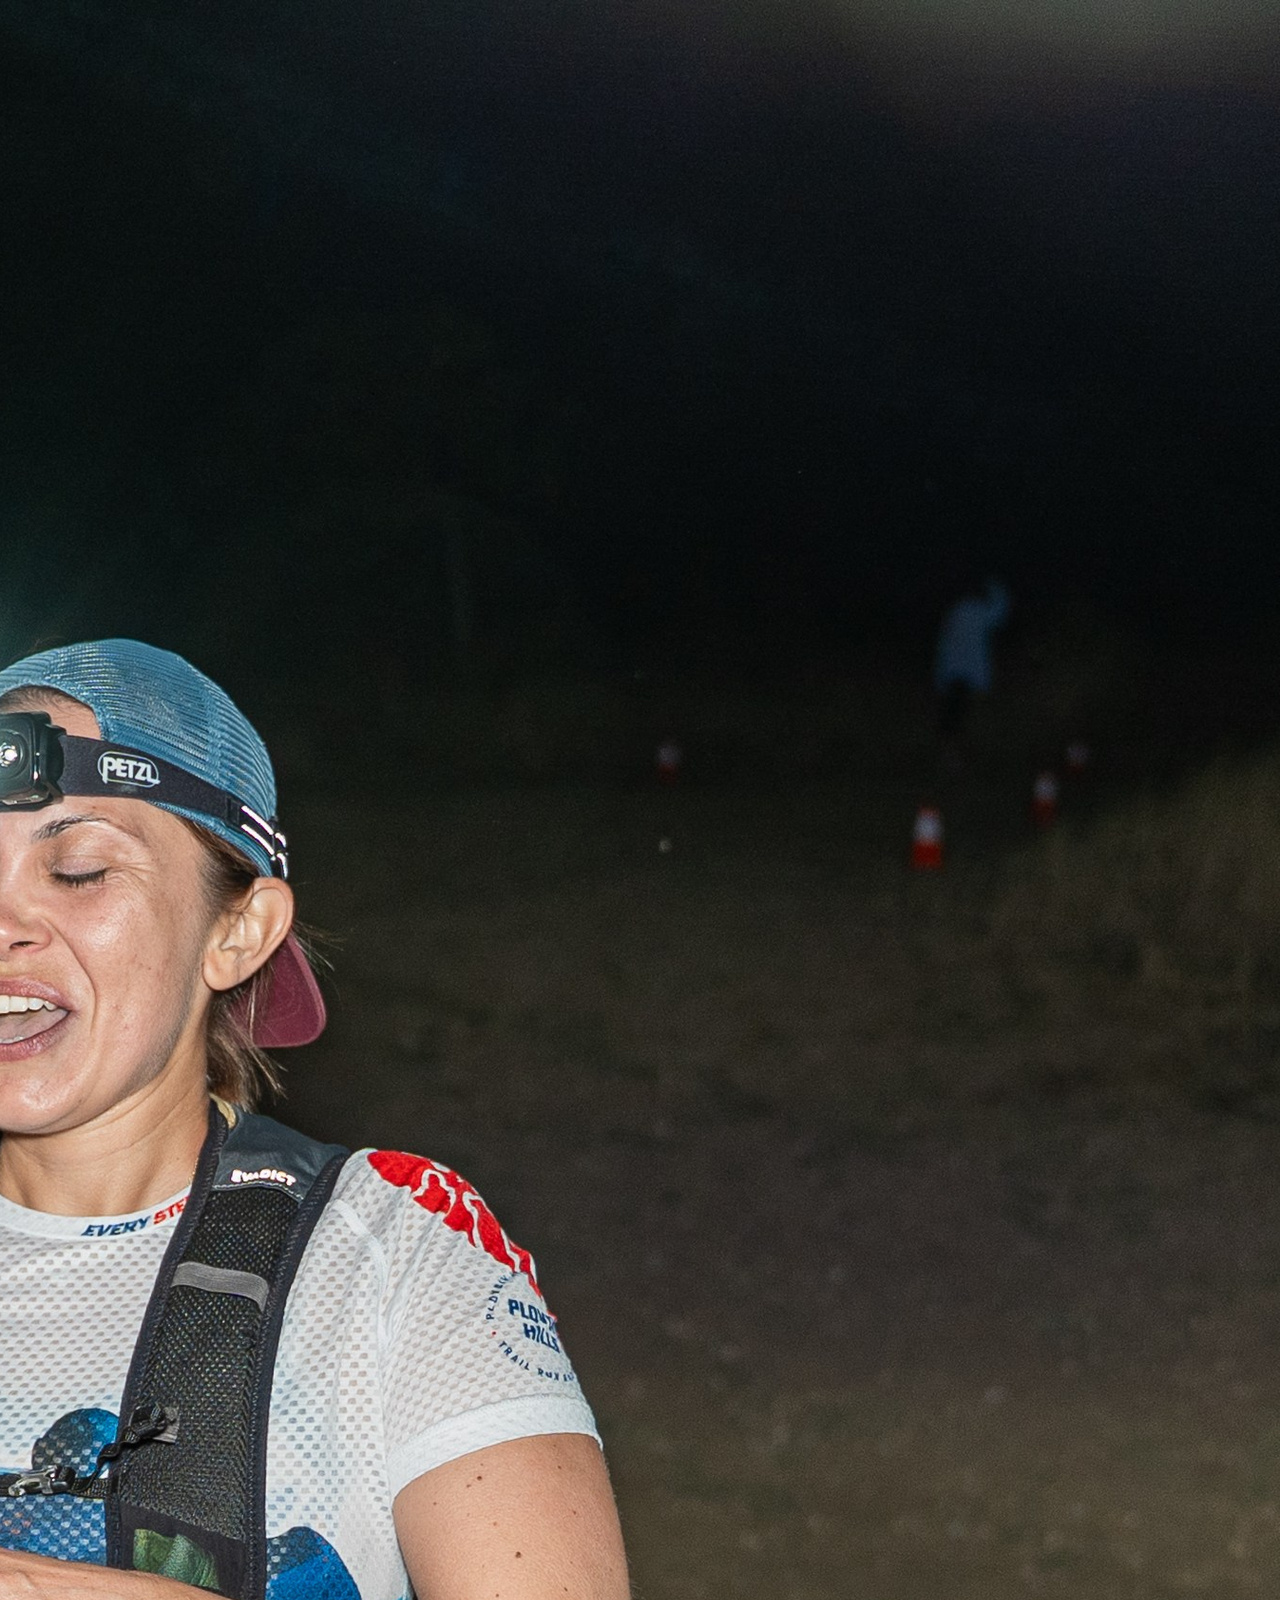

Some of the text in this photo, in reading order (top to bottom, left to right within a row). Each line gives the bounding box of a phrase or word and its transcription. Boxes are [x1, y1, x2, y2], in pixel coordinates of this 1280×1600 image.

[102, 756, 161, 785] PETZL
[81, 1195, 190, 1237] EVERY STE
[523, 1322, 560, 1354] HILLS
[499, 1341, 530, 1371] TRAIL
